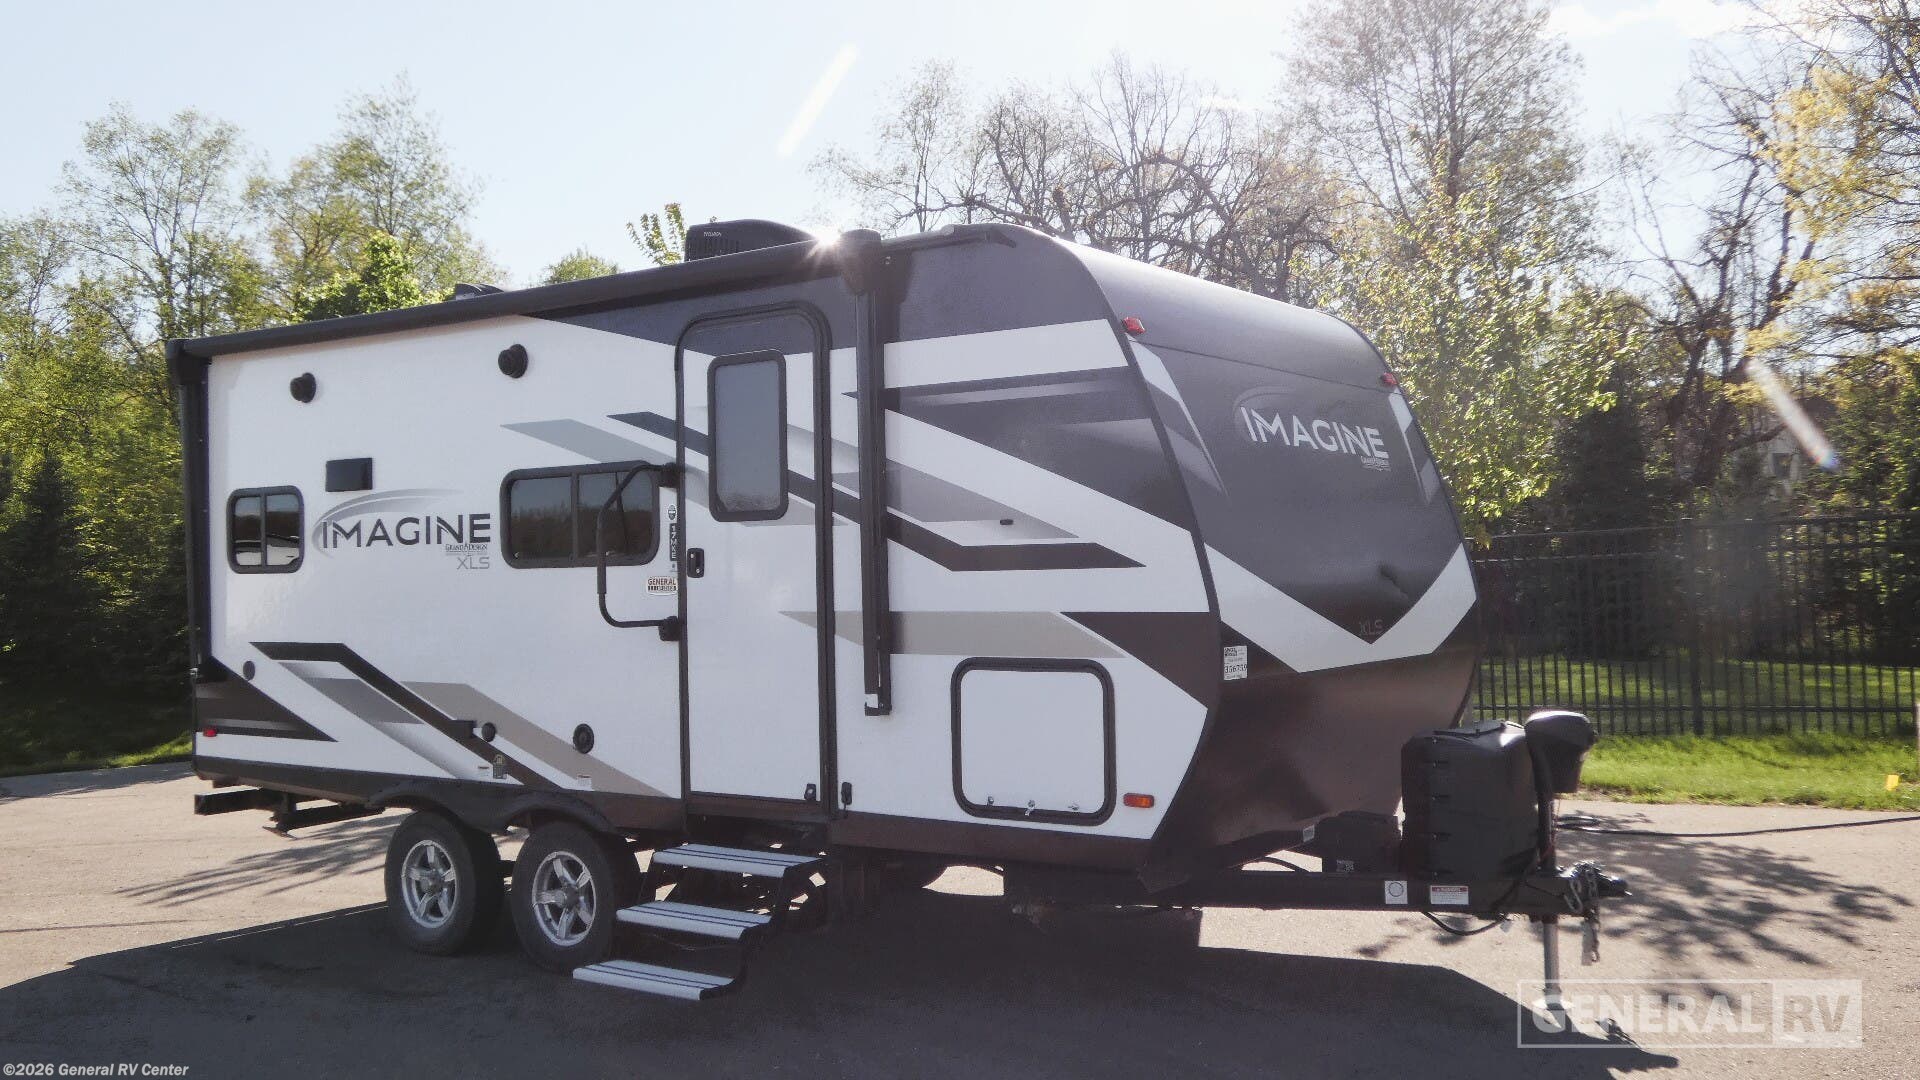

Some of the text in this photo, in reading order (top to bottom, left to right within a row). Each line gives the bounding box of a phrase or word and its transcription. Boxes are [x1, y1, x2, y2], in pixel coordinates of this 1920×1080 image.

[1240, 406, 1390, 459] IMAGINE
[322, 513, 491, 548] IMAGINE
[456, 556, 490, 570] XLS
[647, 578, 677, 586] GENERAL
[1358, 619, 1384, 634] XLS
